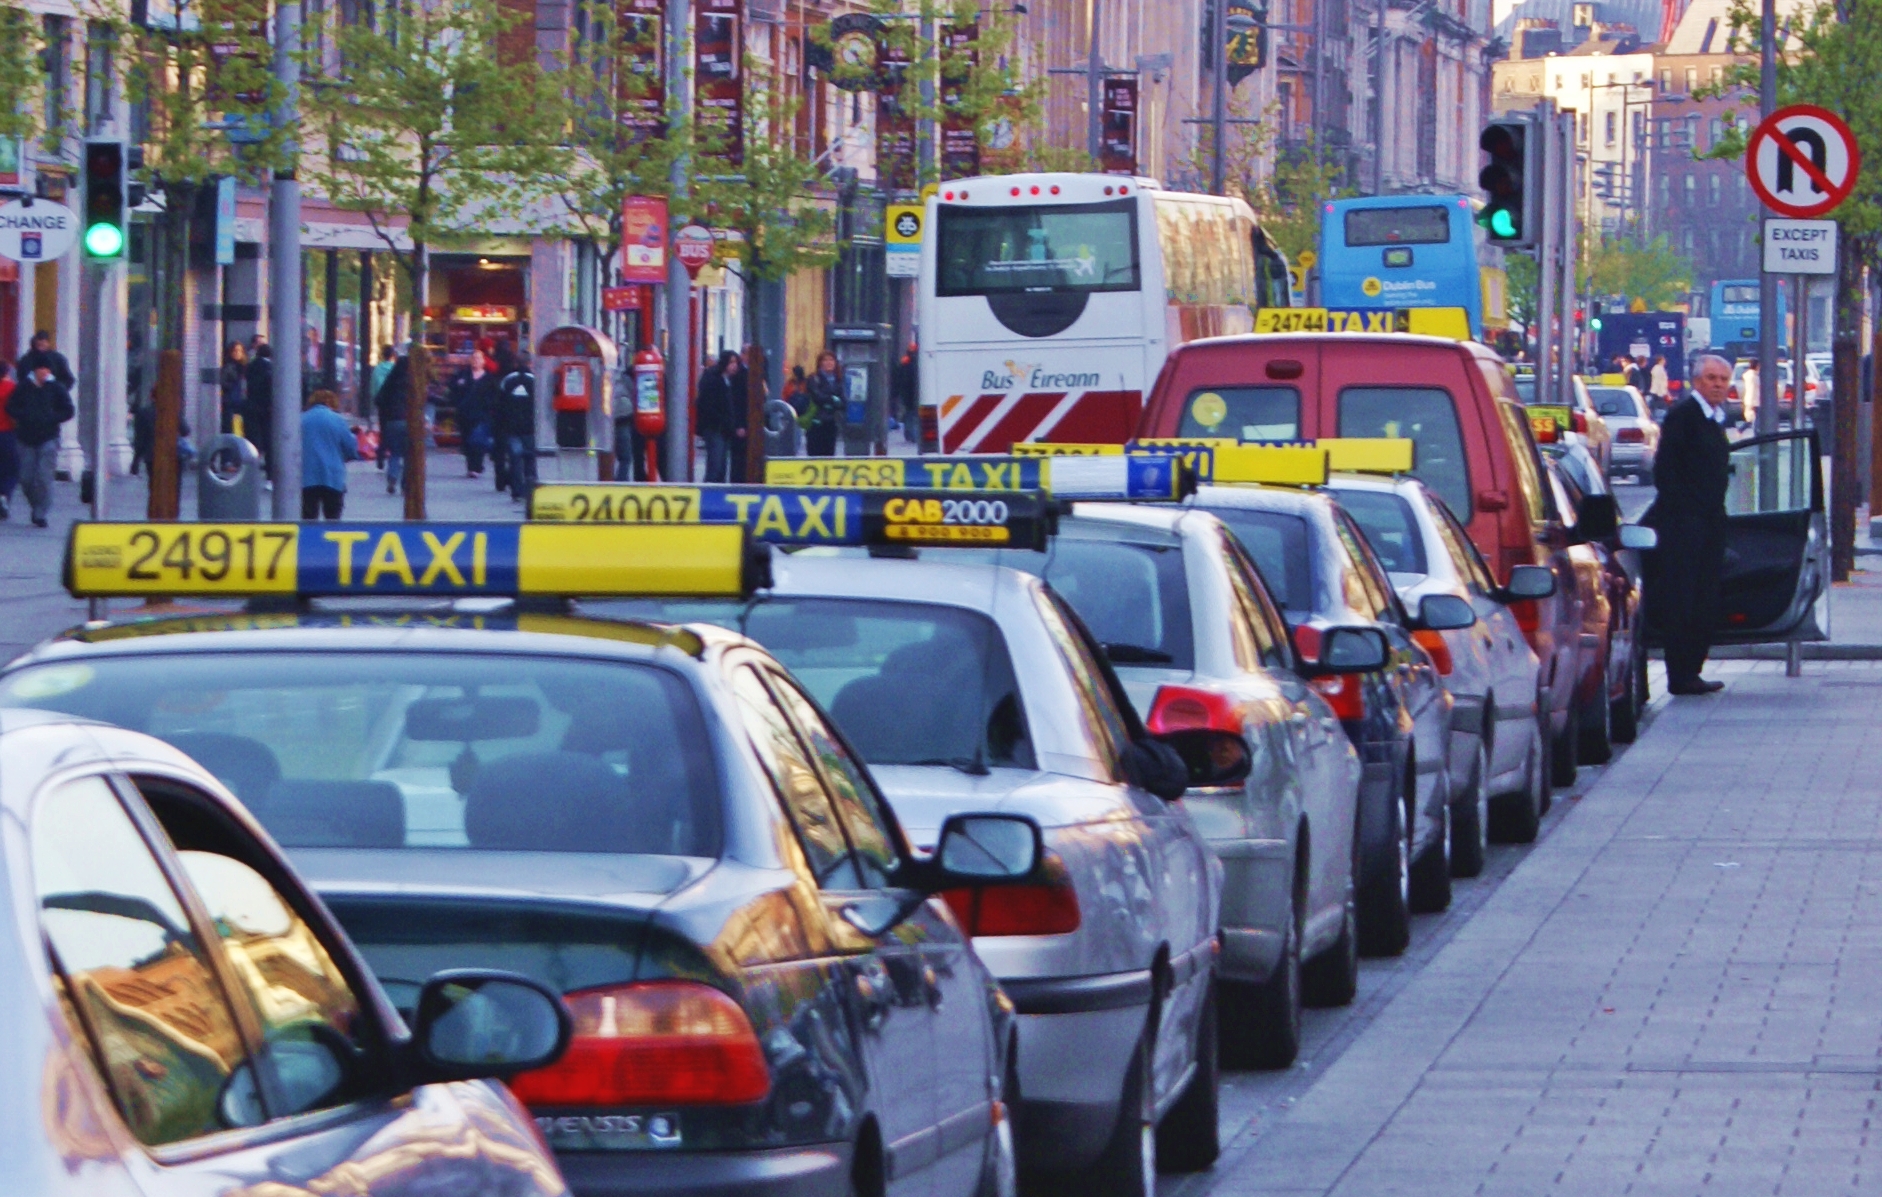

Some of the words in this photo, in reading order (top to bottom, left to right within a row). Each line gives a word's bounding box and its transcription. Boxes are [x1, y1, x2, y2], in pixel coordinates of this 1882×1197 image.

[1772, 228, 1828, 241] EXCEPT
[679, 244, 710, 258] BUS
[1780, 247, 1820, 260] TAXIS
[1271, 313, 1324, 332] 24744
[1329, 311, 1394, 332] TAXI
[981, 370, 1014, 389] Bus
[801, 464, 896, 486] 21768
[924, 462, 1021, 490] TAXI
[571, 493, 692, 521] 24007
[725, 494, 847, 538] TAXI
[126, 529, 295, 581] 24917
[323, 530, 489, 587] TAXI
